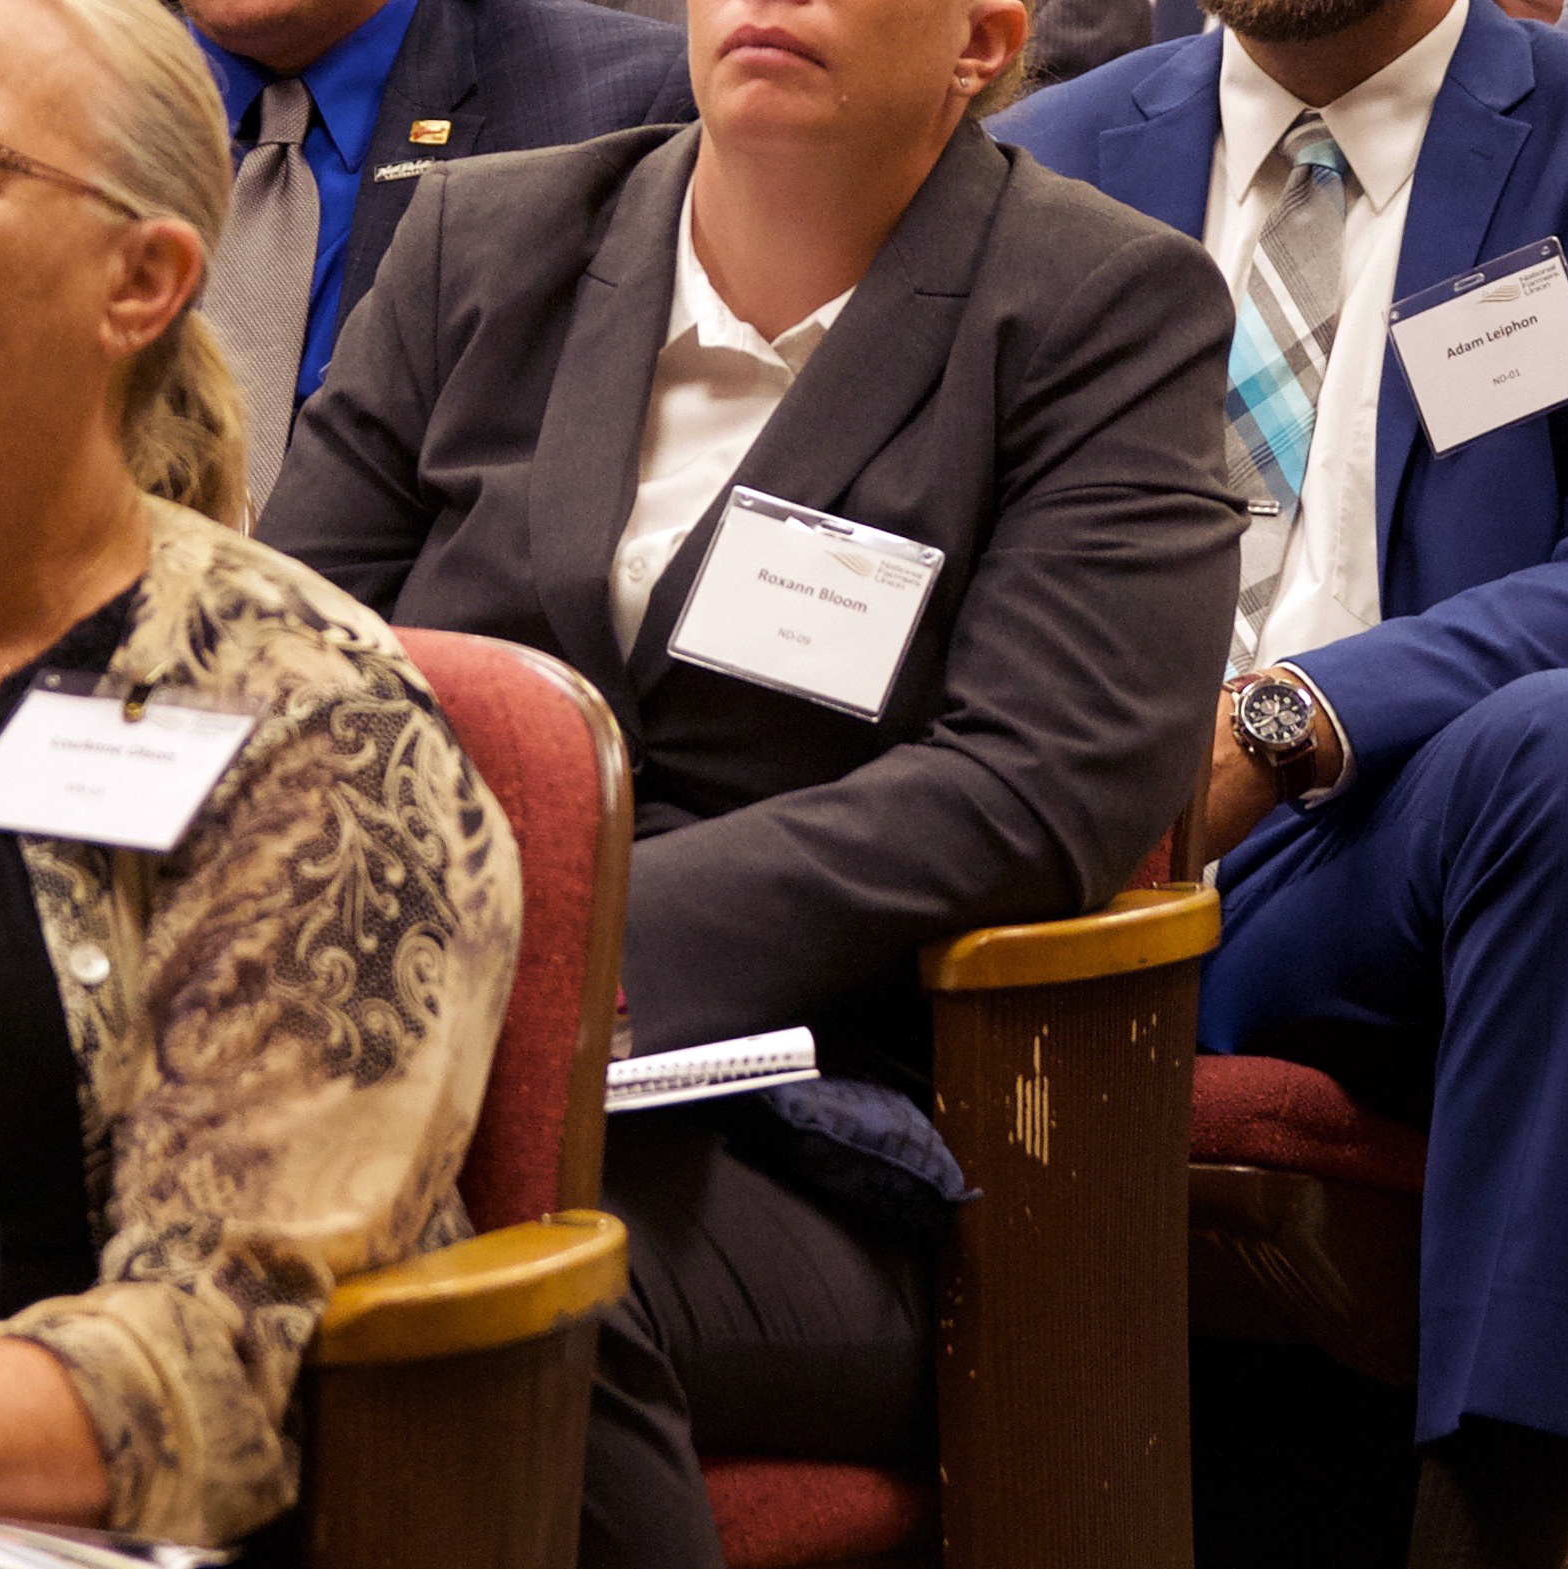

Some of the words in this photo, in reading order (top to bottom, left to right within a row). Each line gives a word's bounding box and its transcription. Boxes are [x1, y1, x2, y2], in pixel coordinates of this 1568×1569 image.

[1447, 336, 1484, 359] Adam
[1486, 315, 1538, 342] Leiphon
[1492, 368, 1521, 386] ND-01
[757, 567, 815, 596] Roxann
[819, 587, 868, 613] Bloom
